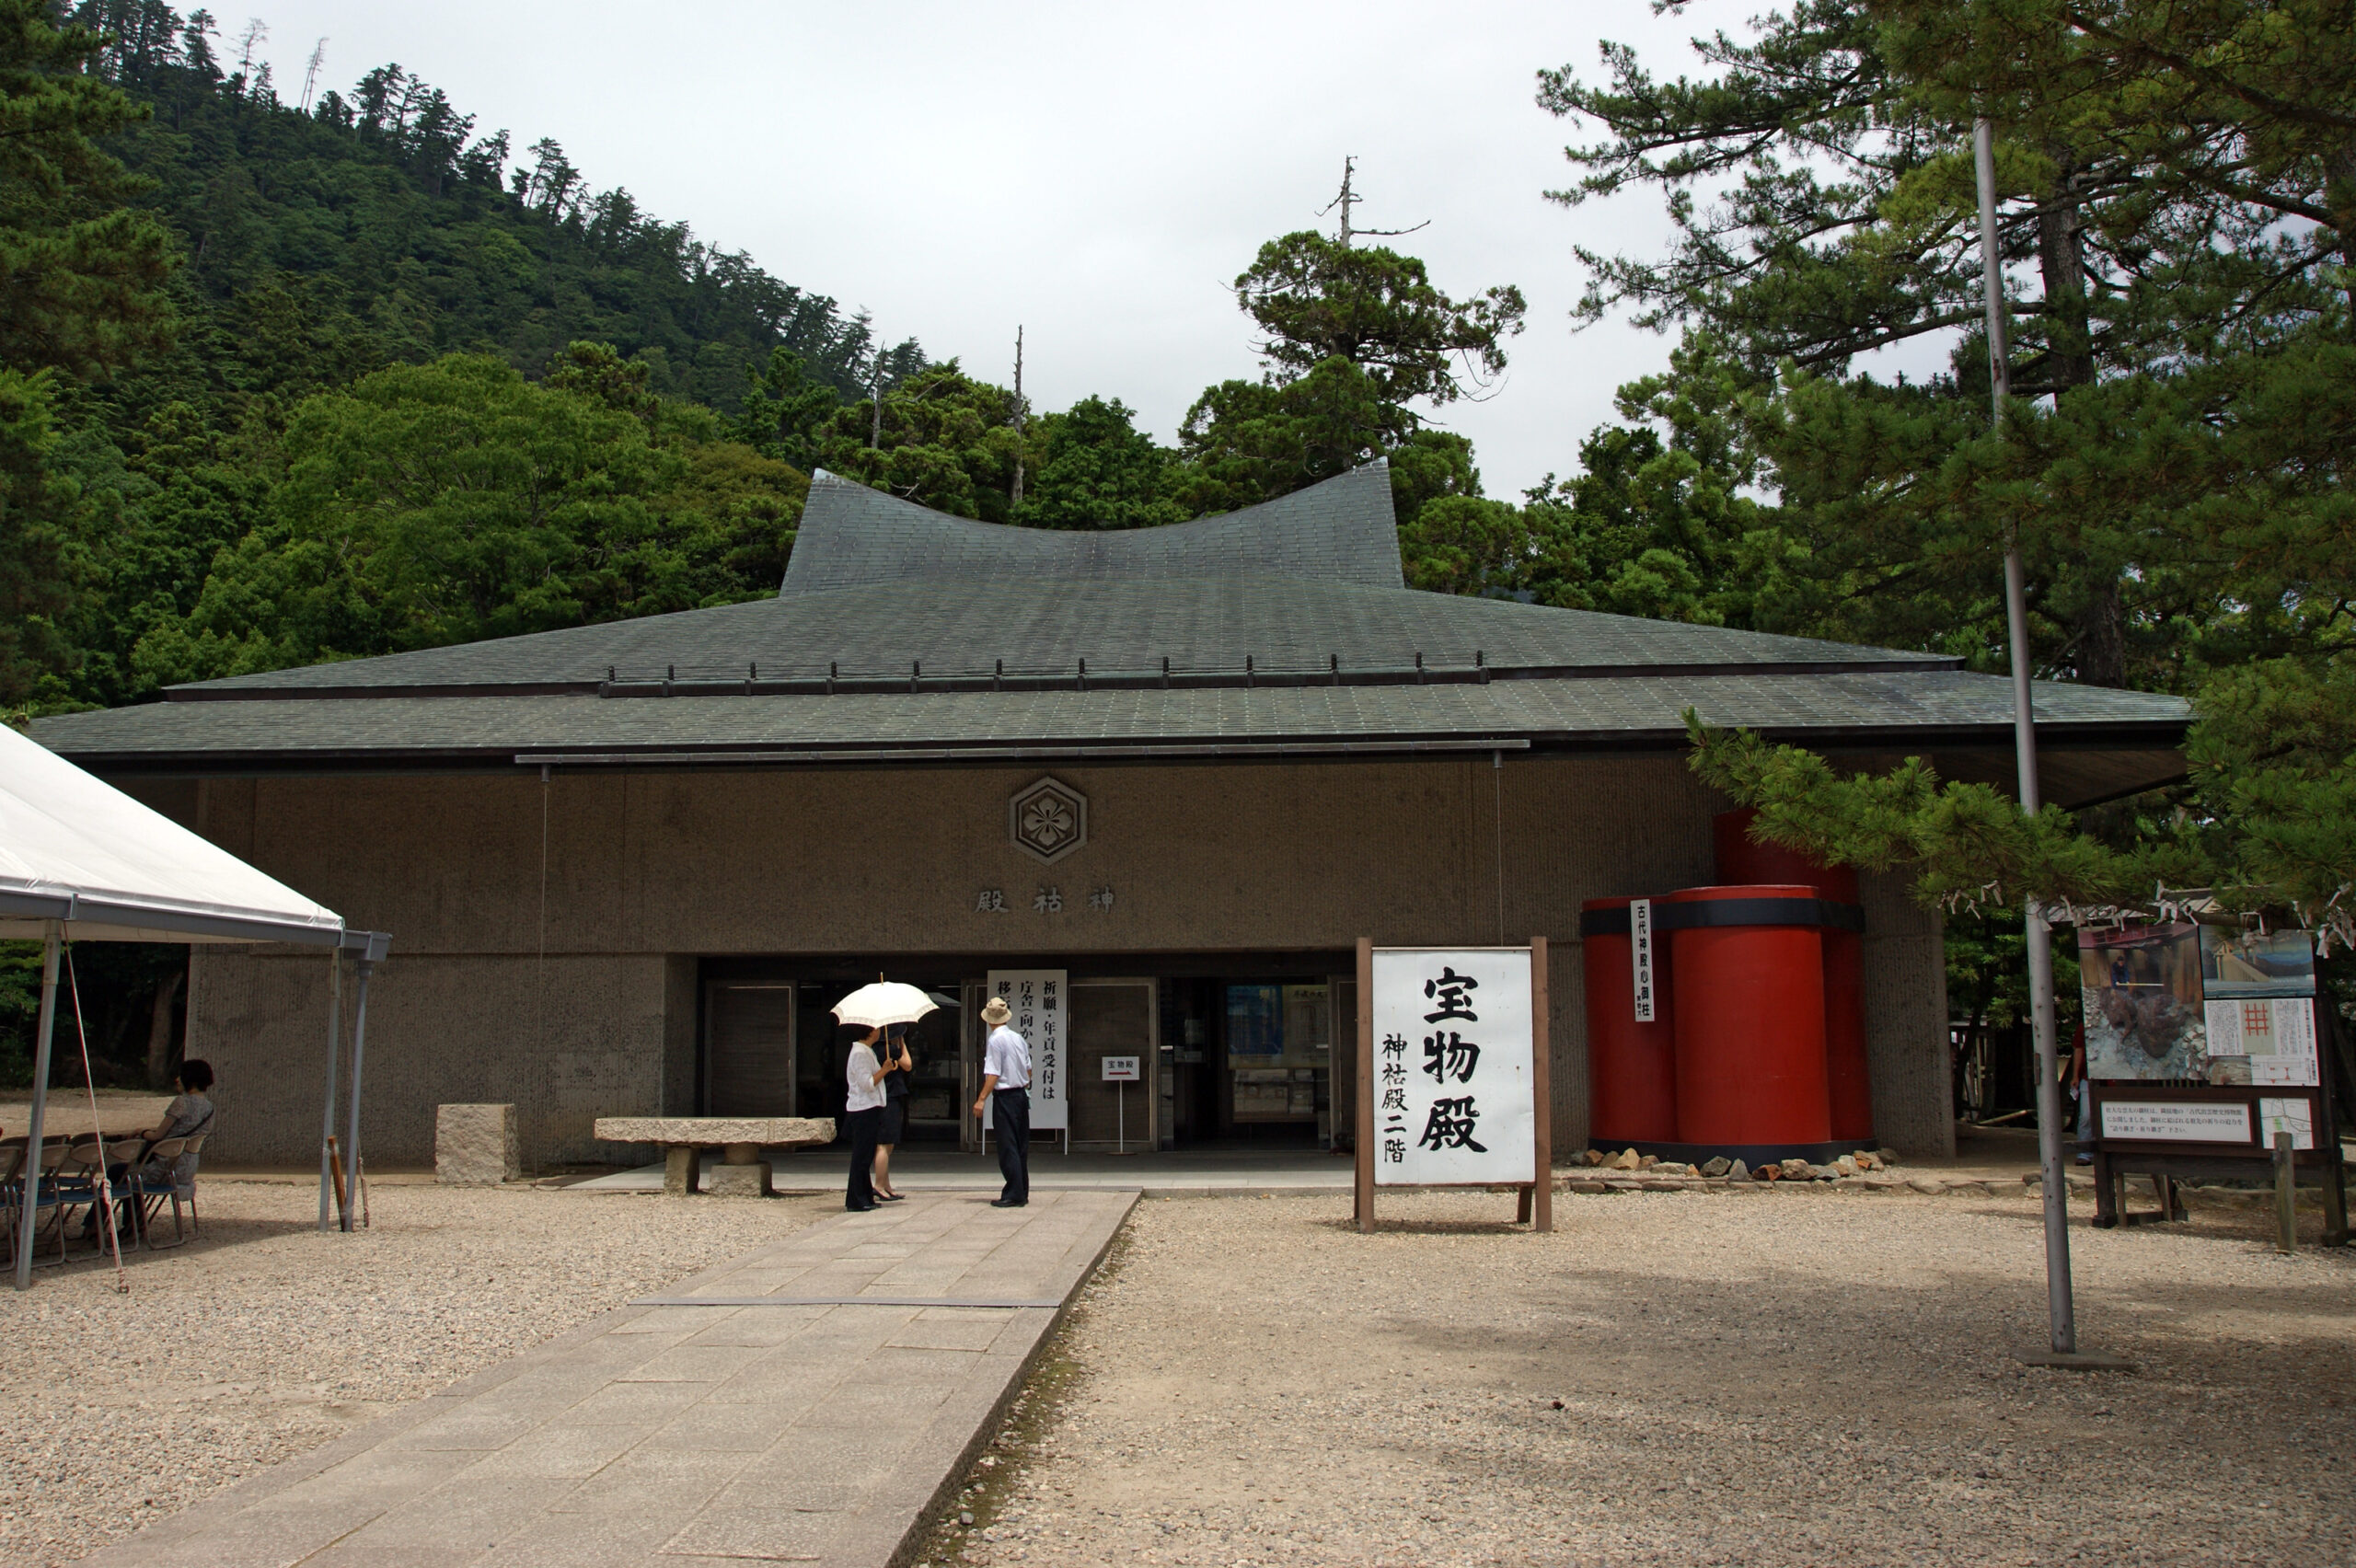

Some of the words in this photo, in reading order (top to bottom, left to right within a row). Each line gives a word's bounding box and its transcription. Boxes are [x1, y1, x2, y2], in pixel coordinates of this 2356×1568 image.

[1637, 905, 1650, 1016] 古代神殿心御柱
[1107, 1060, 1134, 1068] 宝物殿
[1417, 966, 1488, 1153] 宝物殿
